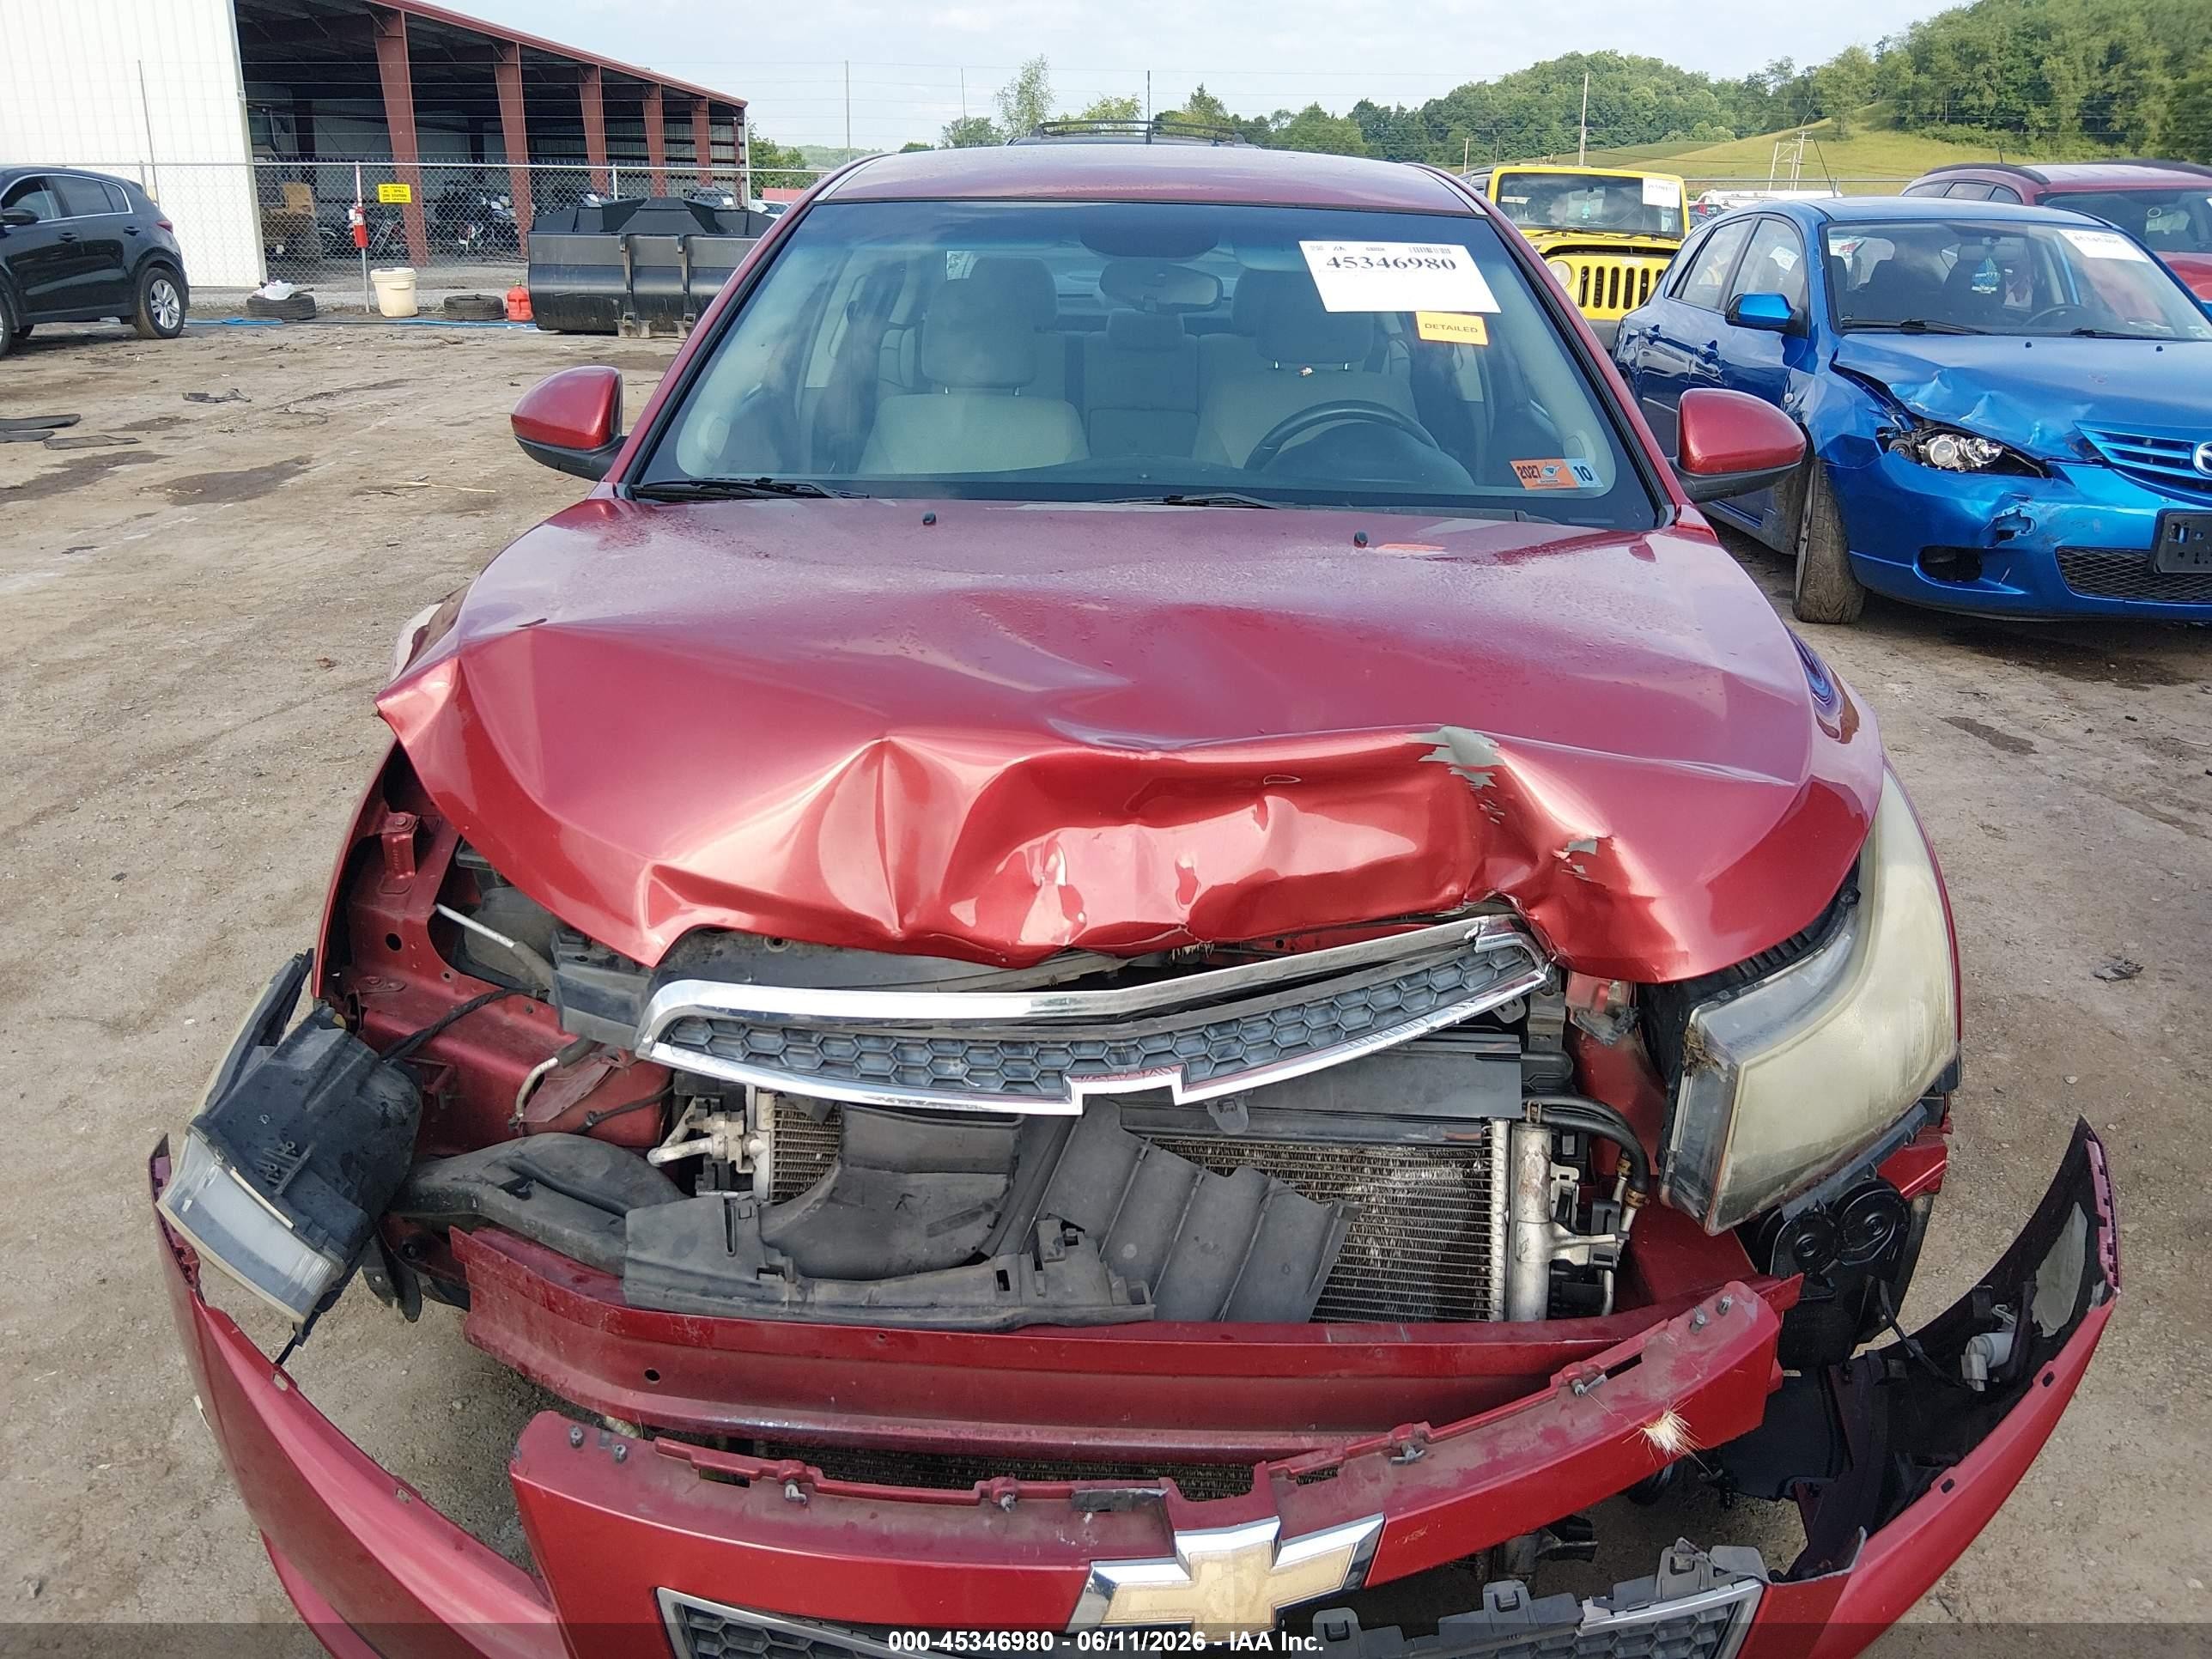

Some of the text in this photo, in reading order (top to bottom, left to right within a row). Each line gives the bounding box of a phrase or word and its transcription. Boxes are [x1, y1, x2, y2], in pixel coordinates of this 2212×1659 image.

[1326, 256, 1456, 270] 45346980
[1425, 323, 1478, 332] DETAILED
[1516, 465, 1594, 482] 2027 10
